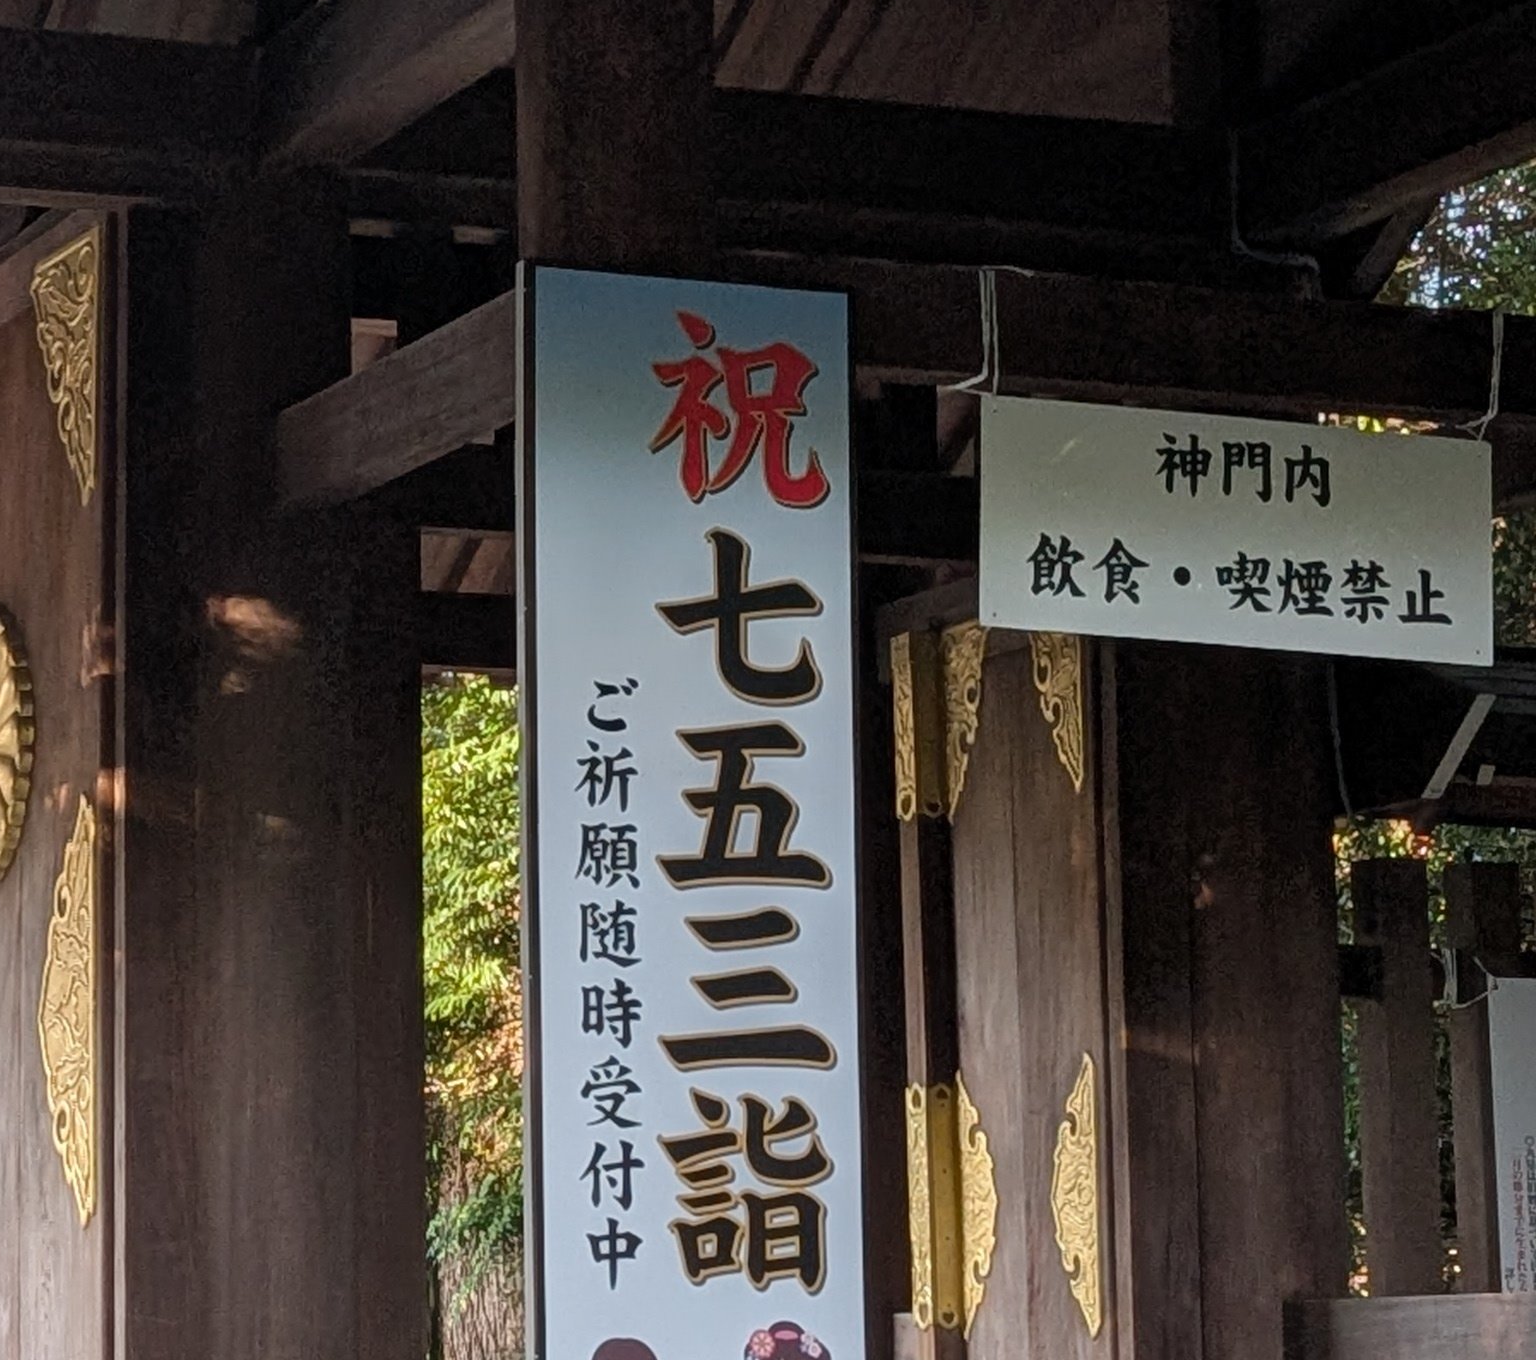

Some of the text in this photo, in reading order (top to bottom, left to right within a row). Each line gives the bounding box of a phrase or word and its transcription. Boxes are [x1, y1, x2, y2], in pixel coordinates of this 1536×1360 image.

[1155, 432, 1331, 507] 神門内
[1026, 533, 1453, 626] 飲食・喫煙禁止
[575, 677, 645, 1290] ご祈願随時受付中
